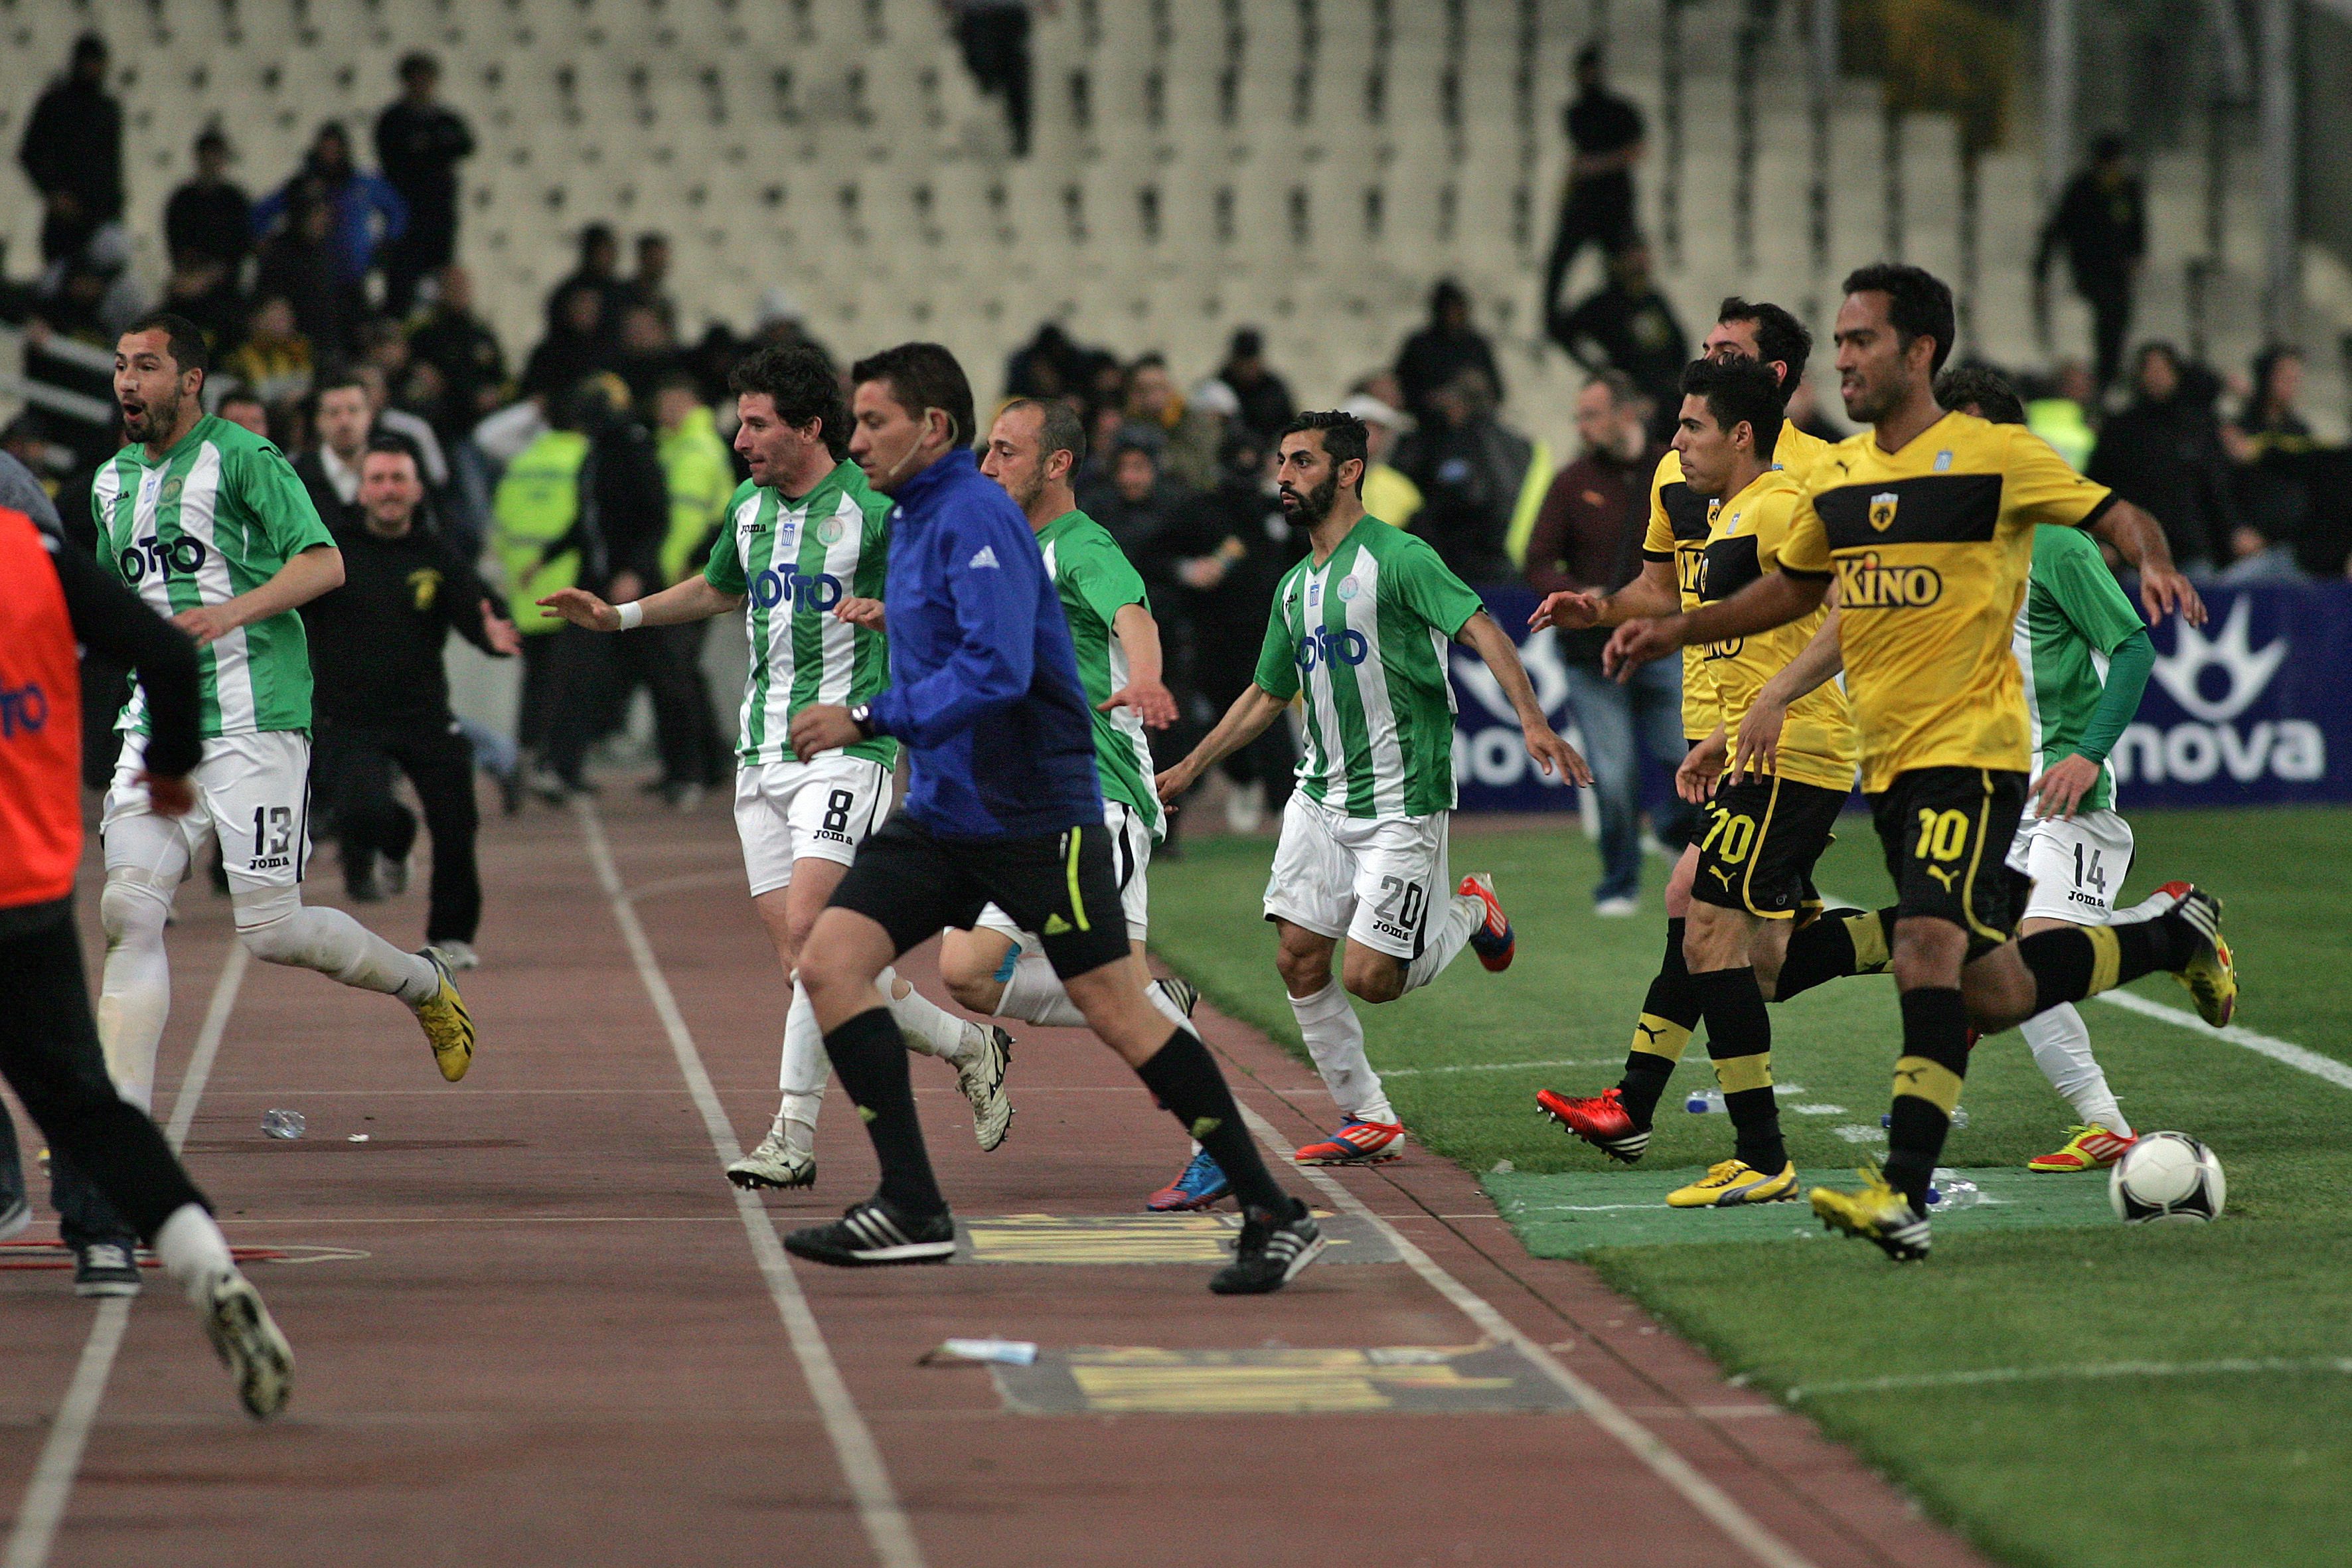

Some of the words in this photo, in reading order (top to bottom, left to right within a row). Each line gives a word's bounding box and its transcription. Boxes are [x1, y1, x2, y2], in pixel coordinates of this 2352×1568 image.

[121, 536, 206, 584] OTTO
[2113, 719, 2325, 785] nova
[254, 807, 291, 855] 13
[823, 789, 854, 832] 8
[1915, 807, 1970, 862] 10
[2074, 842, 2106, 894] 14
[1373, 875, 1423, 931] 20
